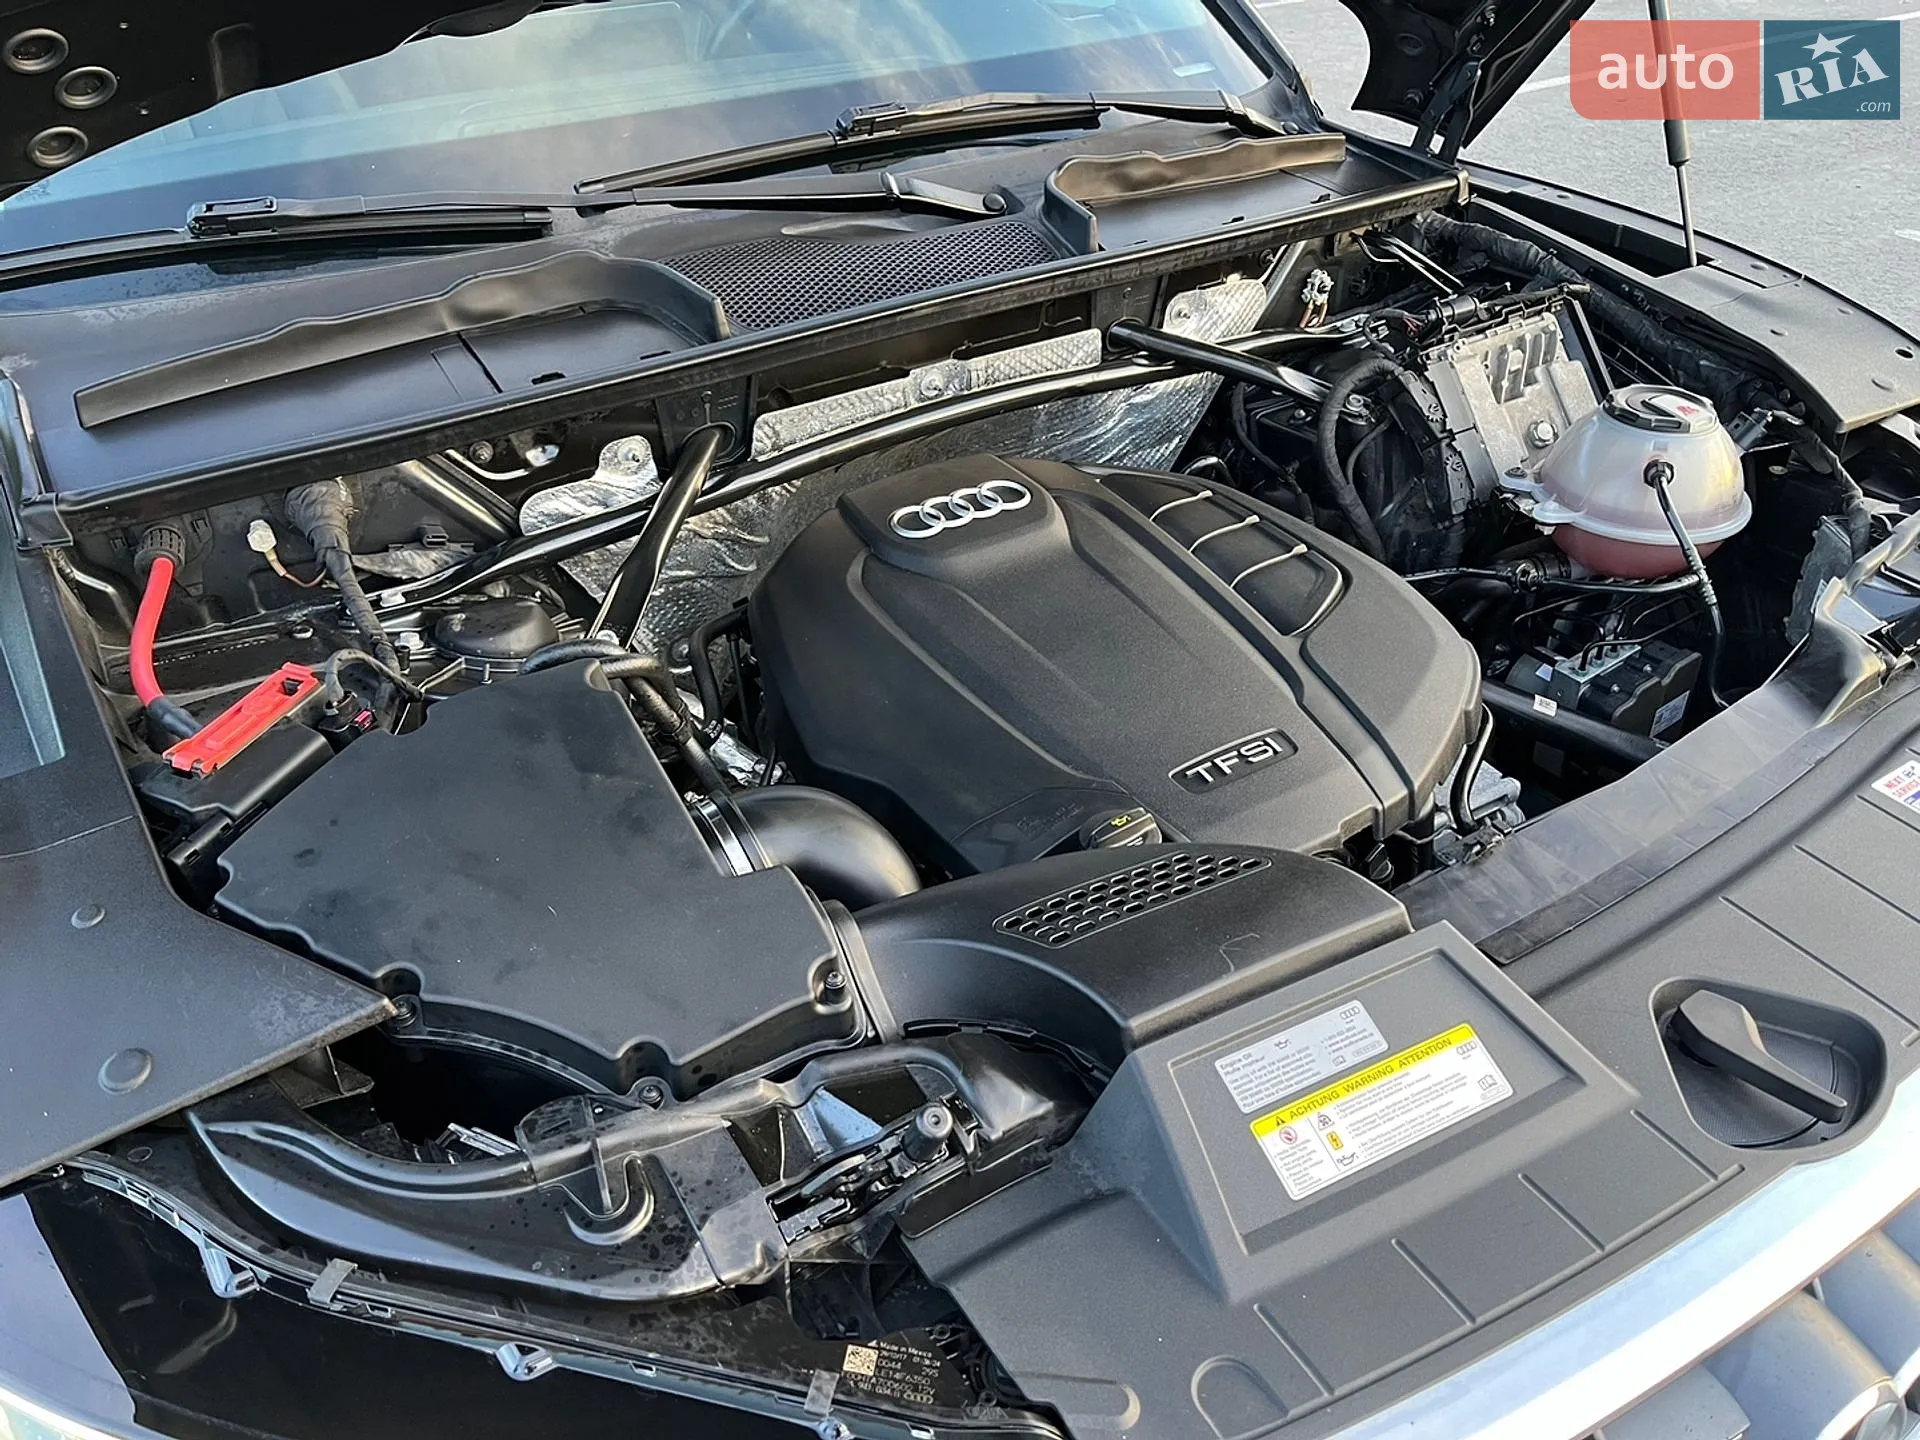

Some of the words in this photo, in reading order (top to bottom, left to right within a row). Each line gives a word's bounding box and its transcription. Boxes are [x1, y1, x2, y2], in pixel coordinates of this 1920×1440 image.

[1185, 737, 1283, 784] TFSI
[1288, 1090, 1341, 1121] ACHTUNG
[1343, 1065, 1395, 1094] WARNING
[1398, 1037, 1453, 1070] ATTENTION
